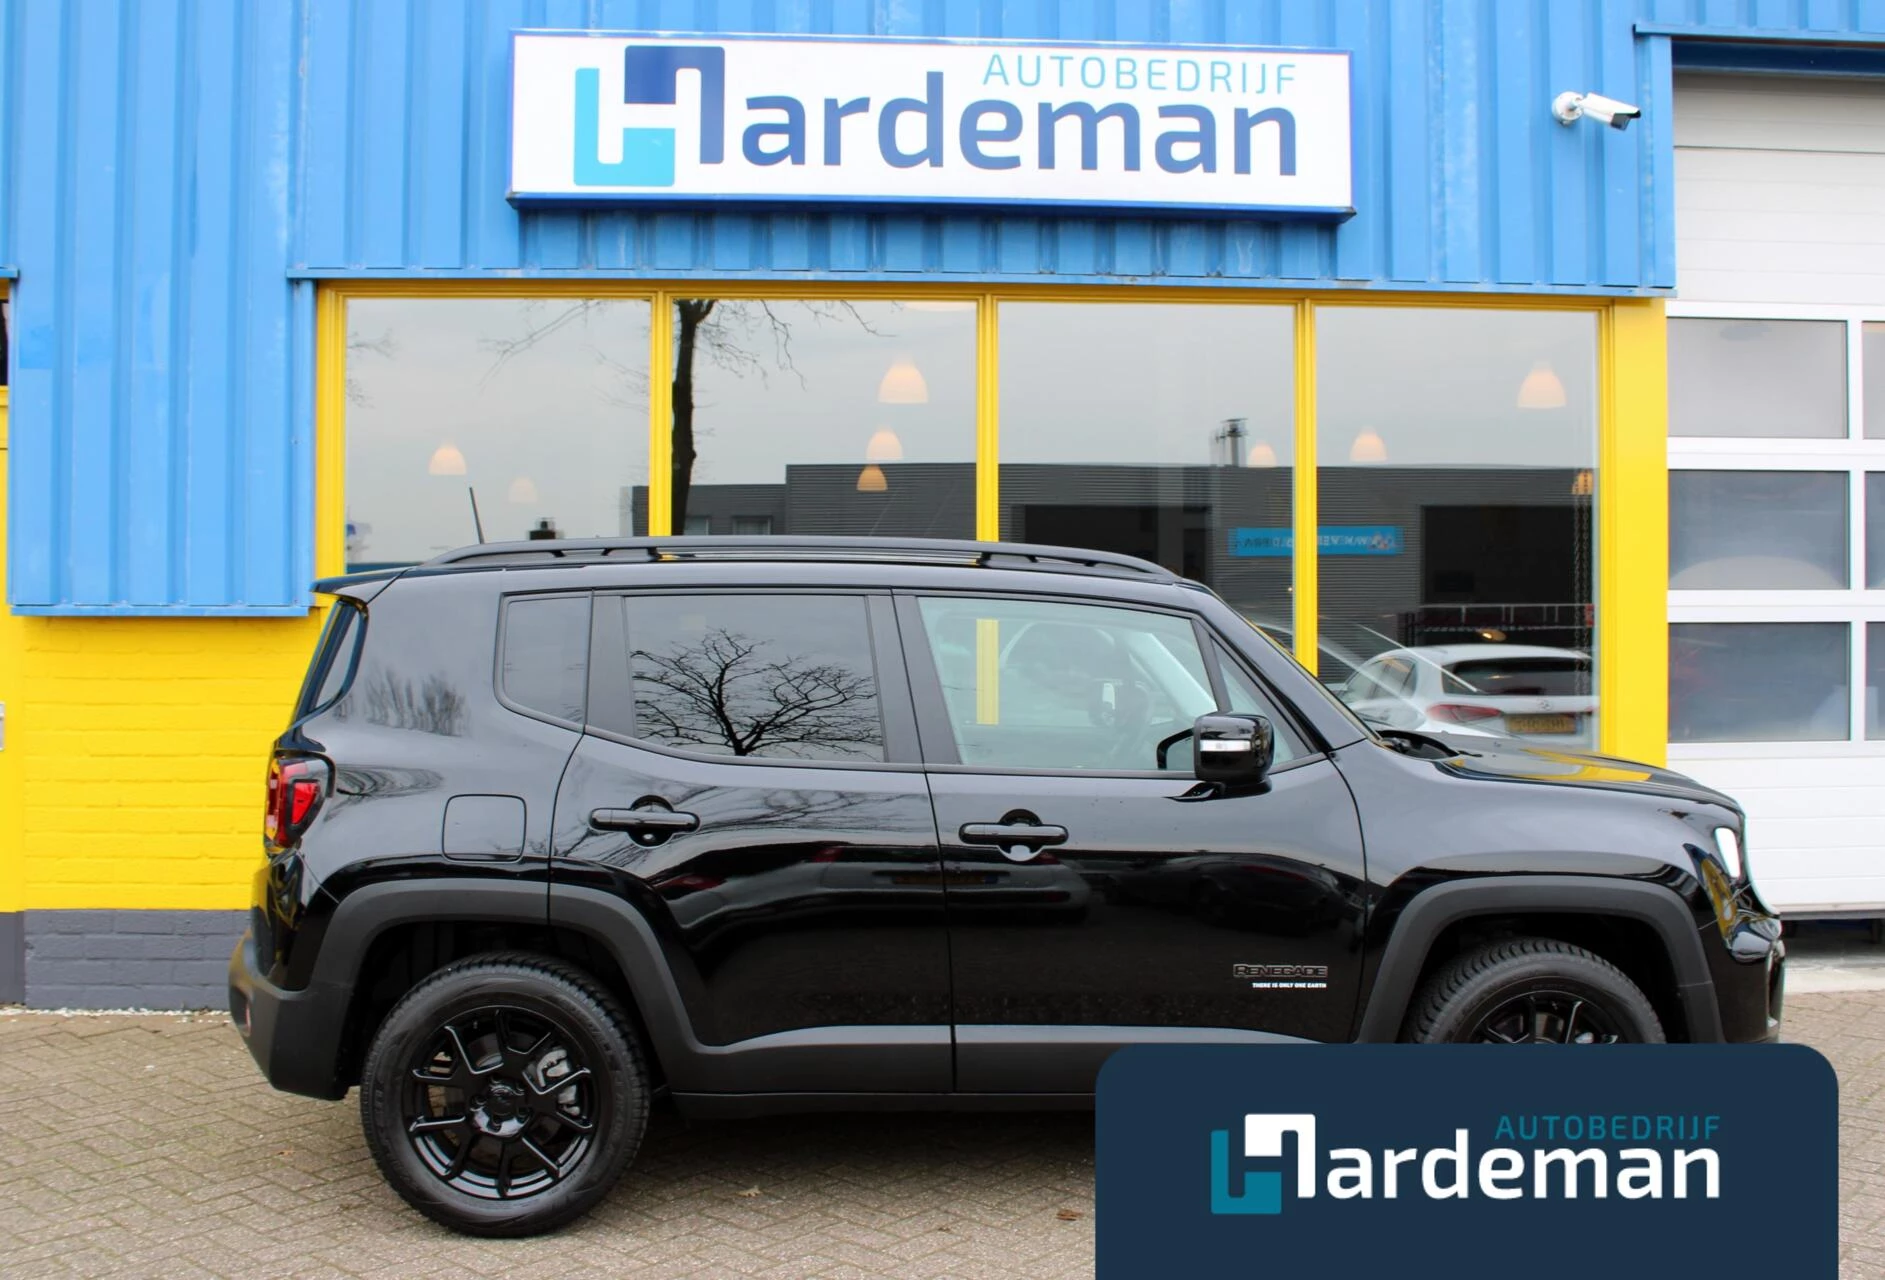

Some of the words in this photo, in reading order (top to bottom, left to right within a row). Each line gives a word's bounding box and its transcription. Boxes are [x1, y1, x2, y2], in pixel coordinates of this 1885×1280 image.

[982, 53, 1297, 94] AUTOBEDRIJF
[573, 45, 1298, 187] Hardeman
[1233, 964, 1328, 978] RENEGADE
